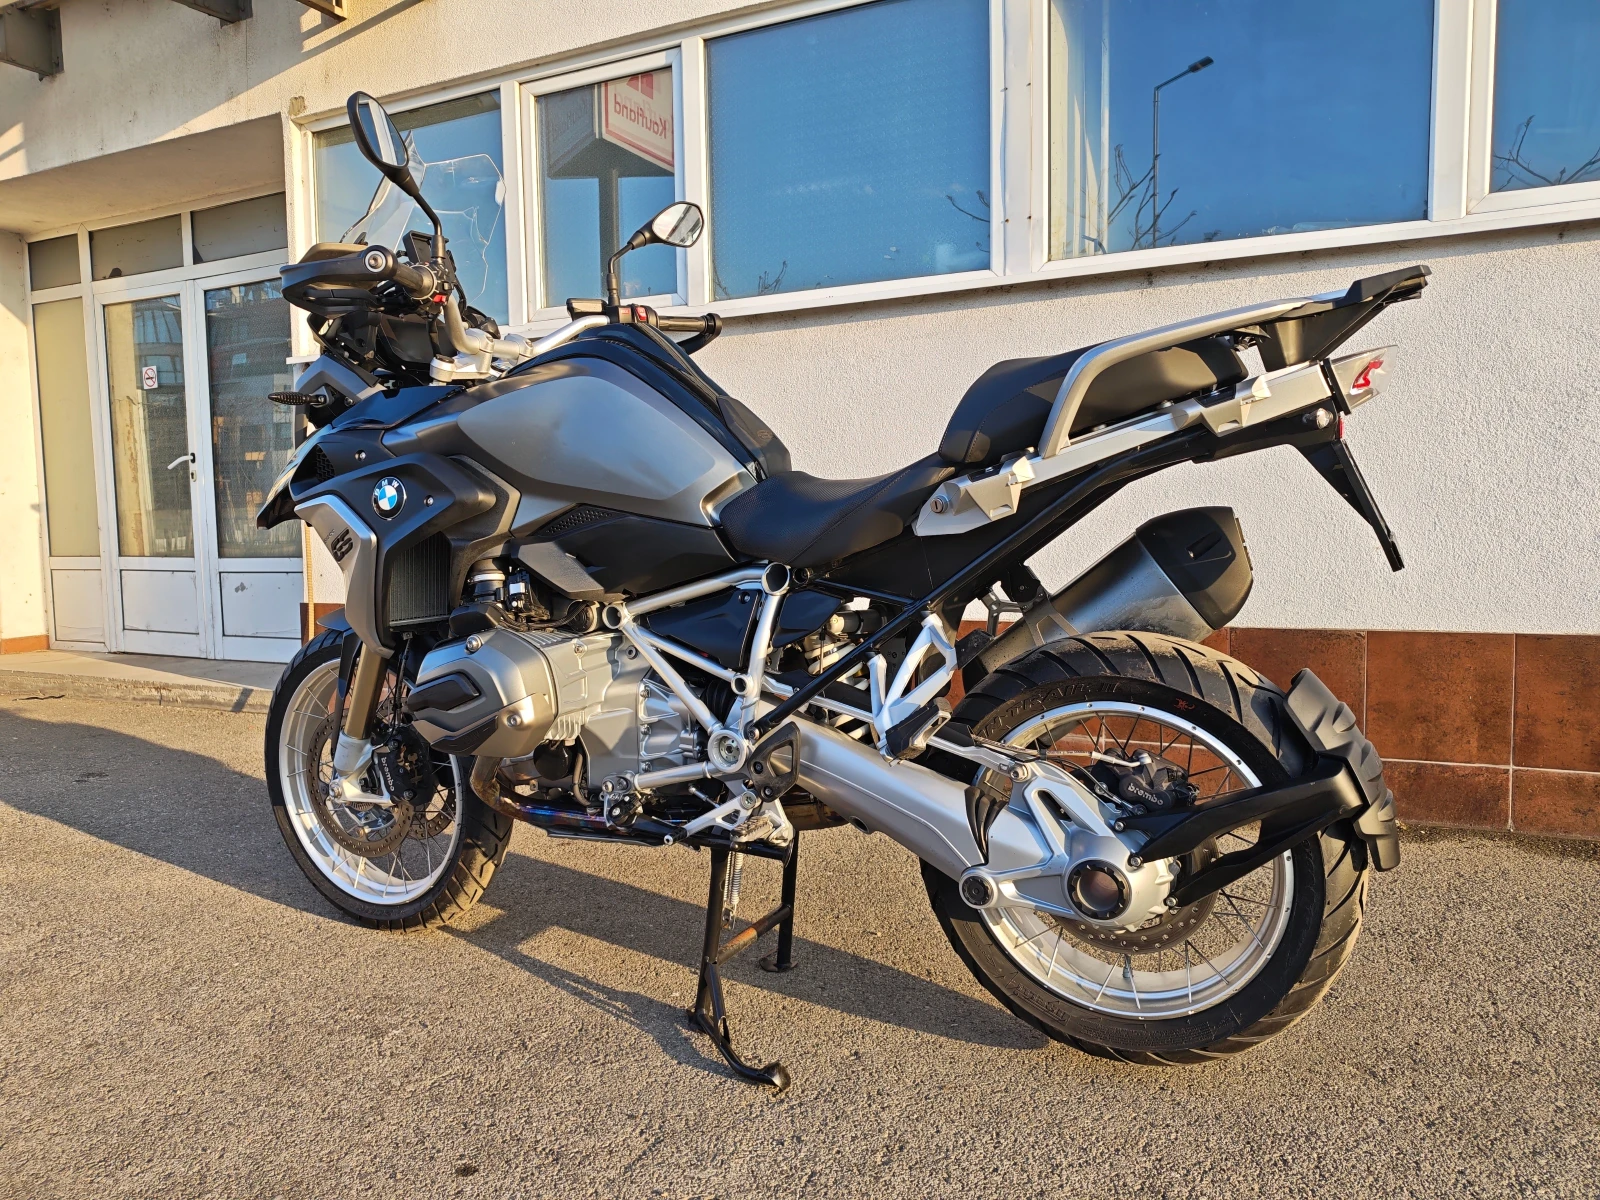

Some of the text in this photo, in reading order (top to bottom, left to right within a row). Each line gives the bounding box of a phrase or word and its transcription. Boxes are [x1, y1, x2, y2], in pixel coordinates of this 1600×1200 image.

[374, 478, 400, 496] BMW
[381, 756, 395, 792] brembo
[1127, 782, 1164, 806] brembo
